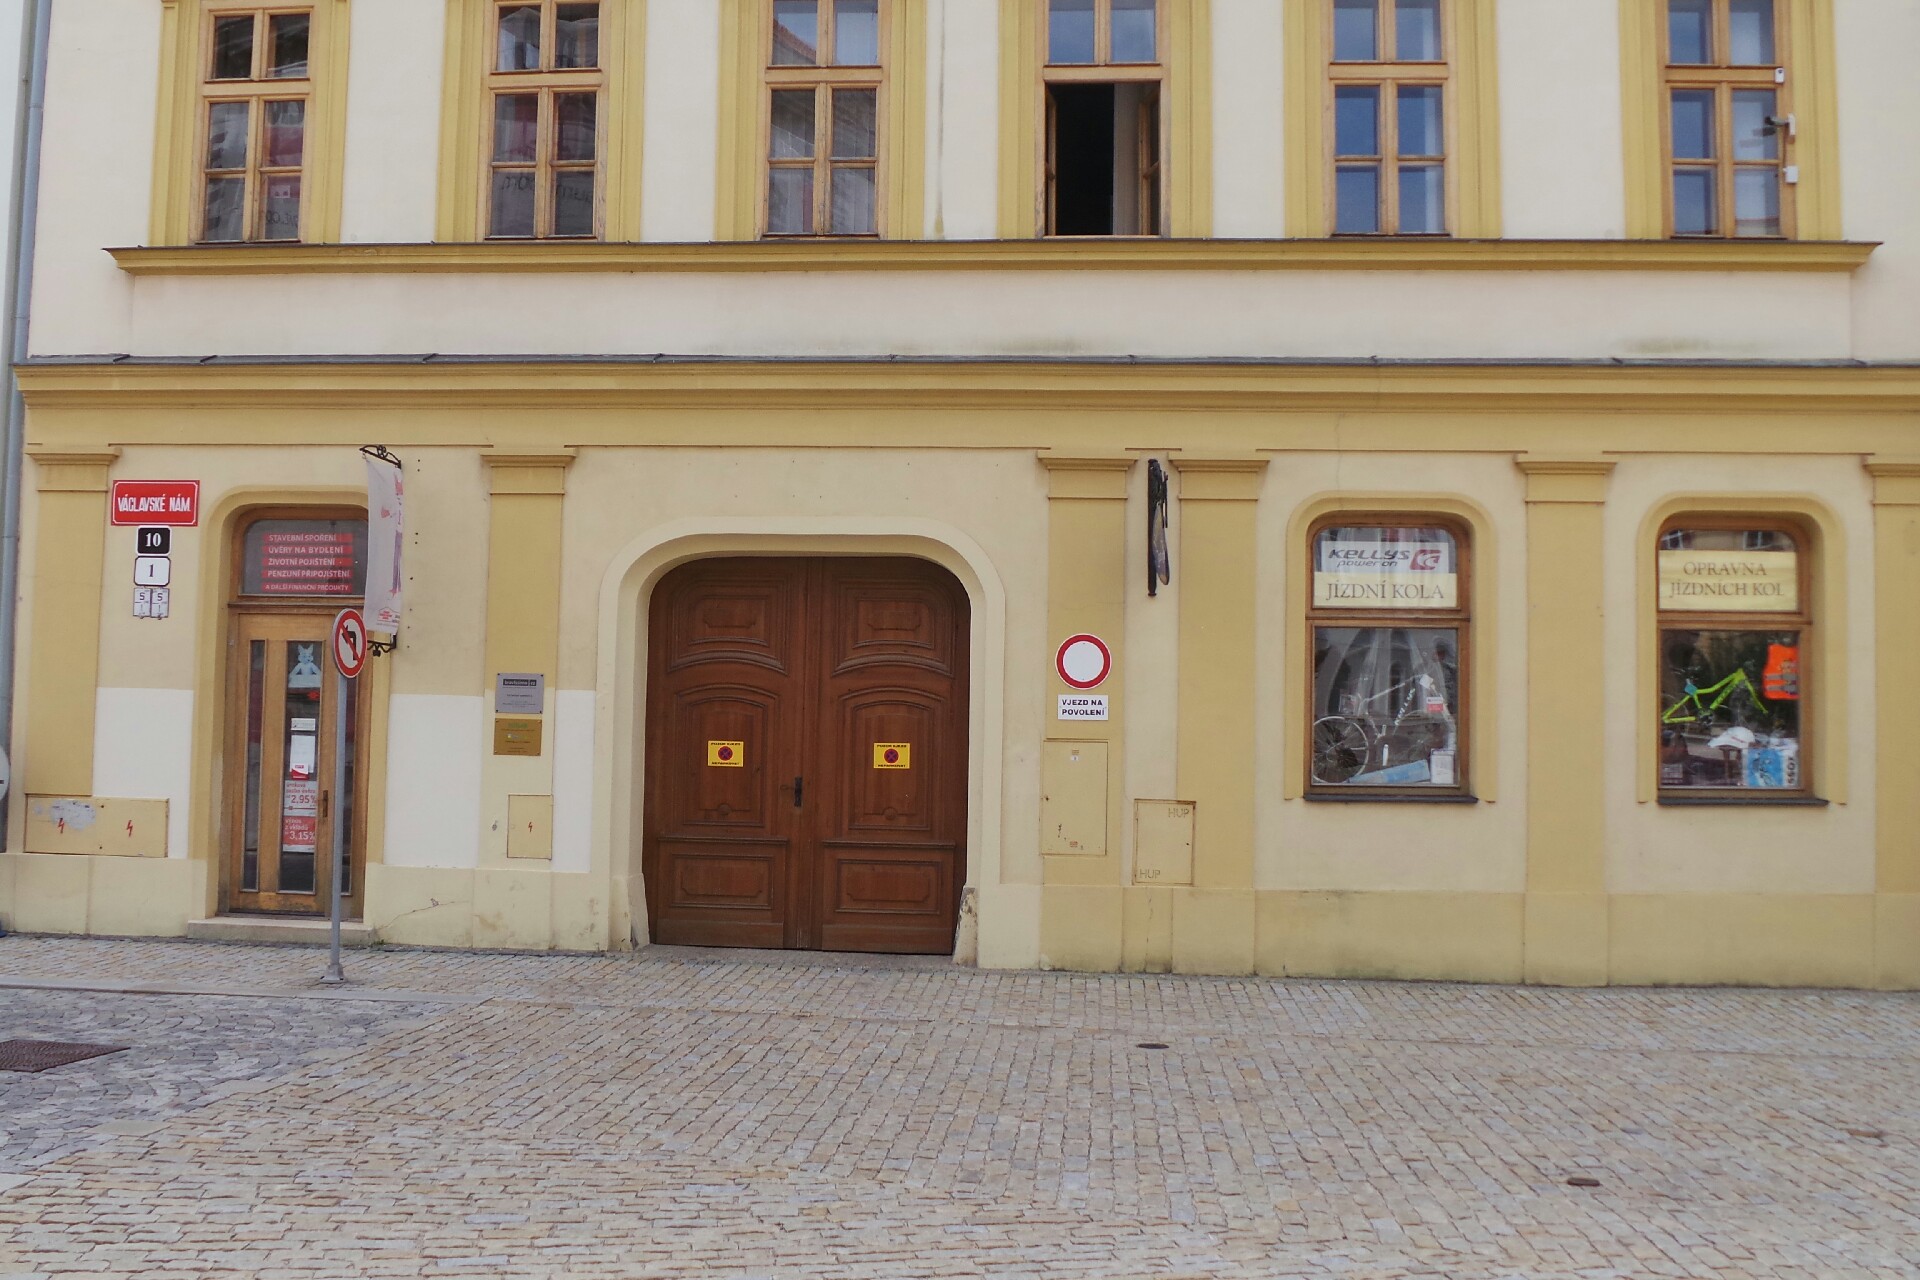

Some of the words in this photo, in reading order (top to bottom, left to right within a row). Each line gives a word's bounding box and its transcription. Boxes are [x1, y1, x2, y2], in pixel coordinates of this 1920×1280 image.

[118, 494, 166, 512] VÁCLAVSKÉ
[145, 532, 162, 547] 10
[269, 533, 304, 542] STAVEBNÍ
[295, 546, 306, 554] NA
[308, 545, 343, 554] BYDLENÍ
[268, 557, 297, 566] ŽIVOTNÍ
[148, 564, 154, 578] 1
[1683, 562, 1767, 576] OPRAVNA
[1326, 580, 1387, 600] JÍZDNÍ
[1391, 583, 1444, 599] KOLA
[1669, 579, 1748, 598] JÍZDNÍCH
[1753, 582, 1784, 596] KOL
[1062, 707, 1105, 716] POVOLENÍ
[1168, 808, 1190, 818] HUP
[1139, 869, 1161, 879] HUP
